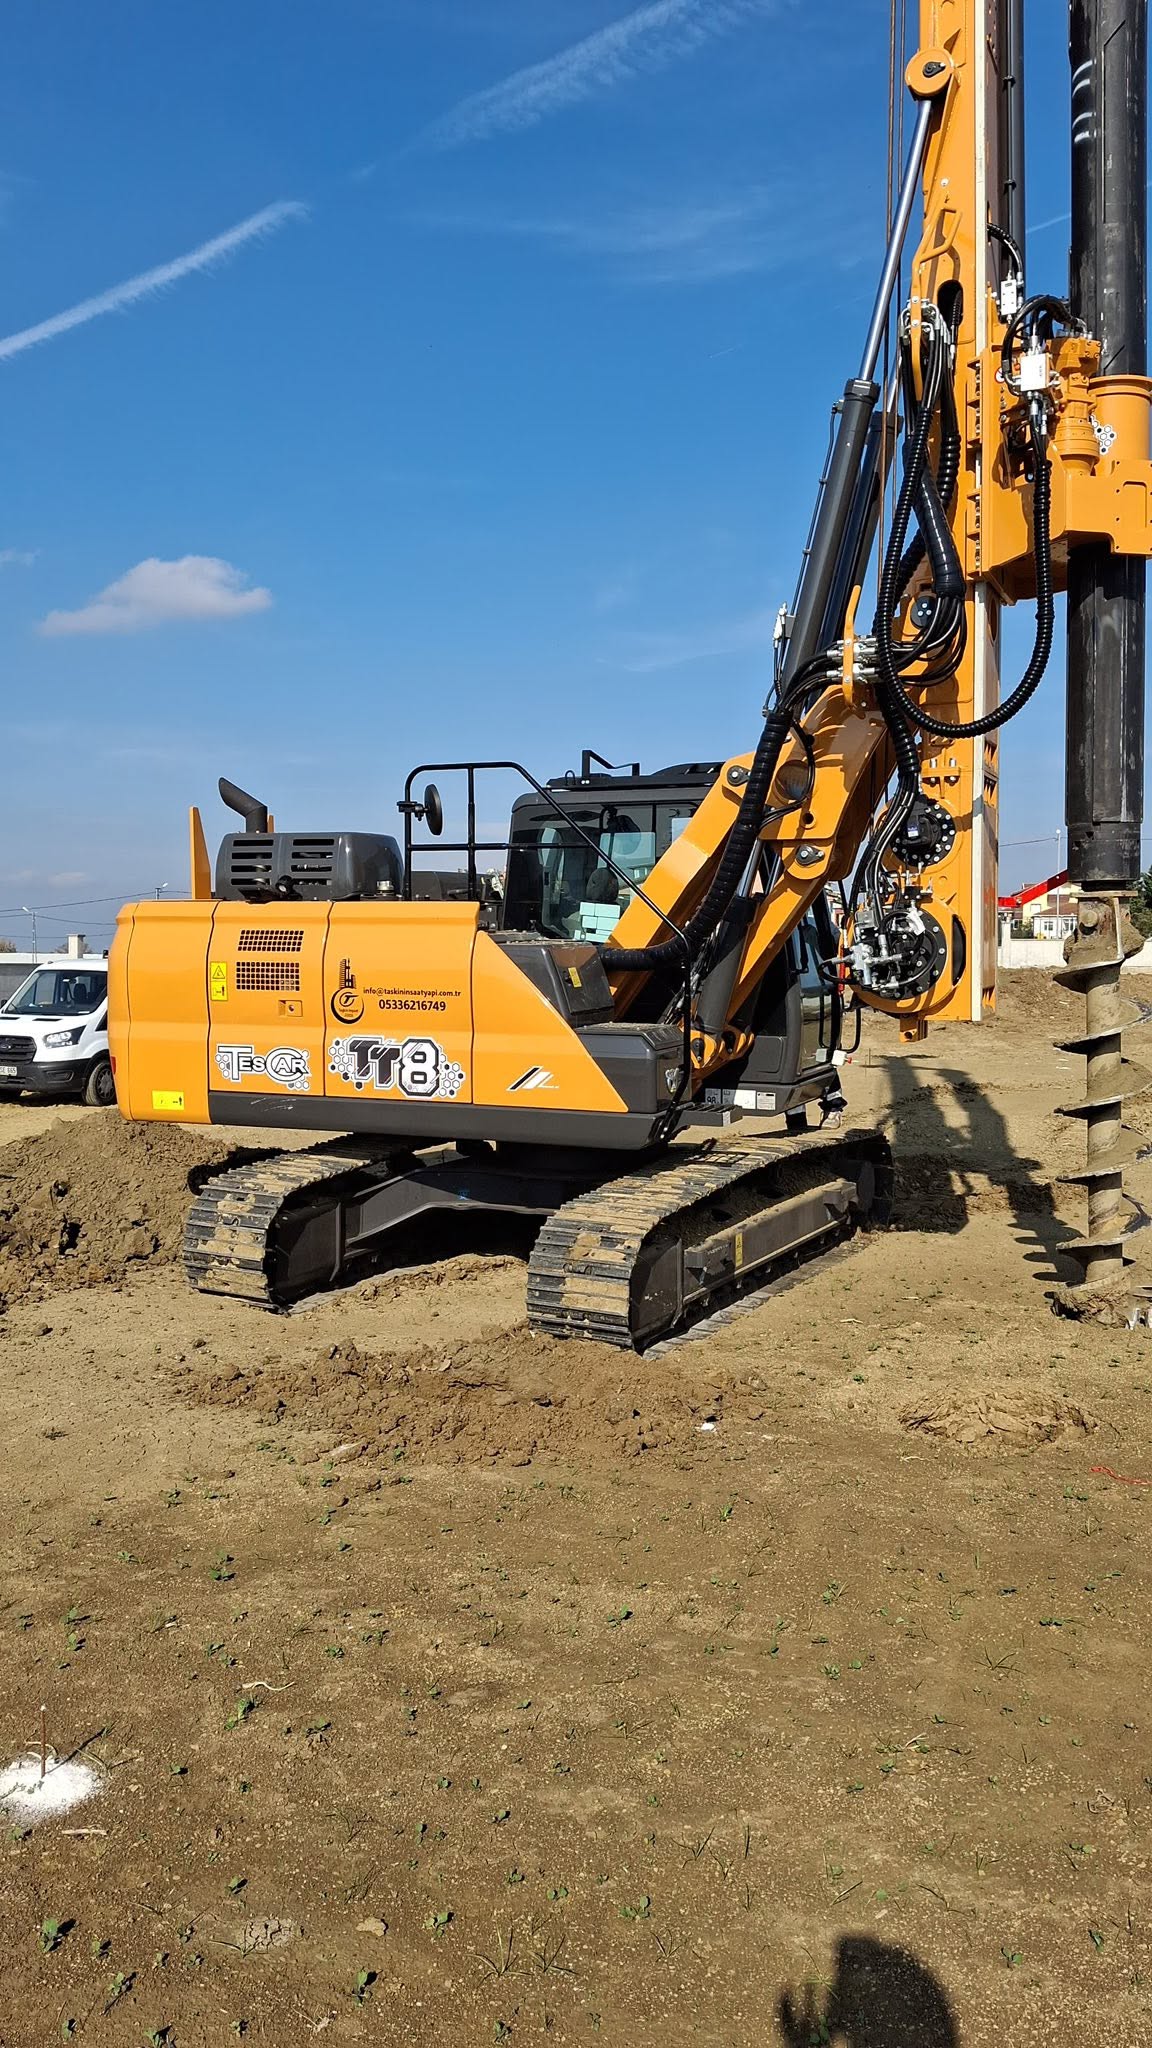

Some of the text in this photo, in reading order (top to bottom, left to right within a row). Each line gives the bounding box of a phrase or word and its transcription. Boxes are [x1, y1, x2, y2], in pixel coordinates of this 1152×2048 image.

[363, 987, 461, 997] info@taskininsaatyapi.com.tr
[378, 999, 447, 1011] 05336216749
[349, 1037, 440, 1097] TT8
